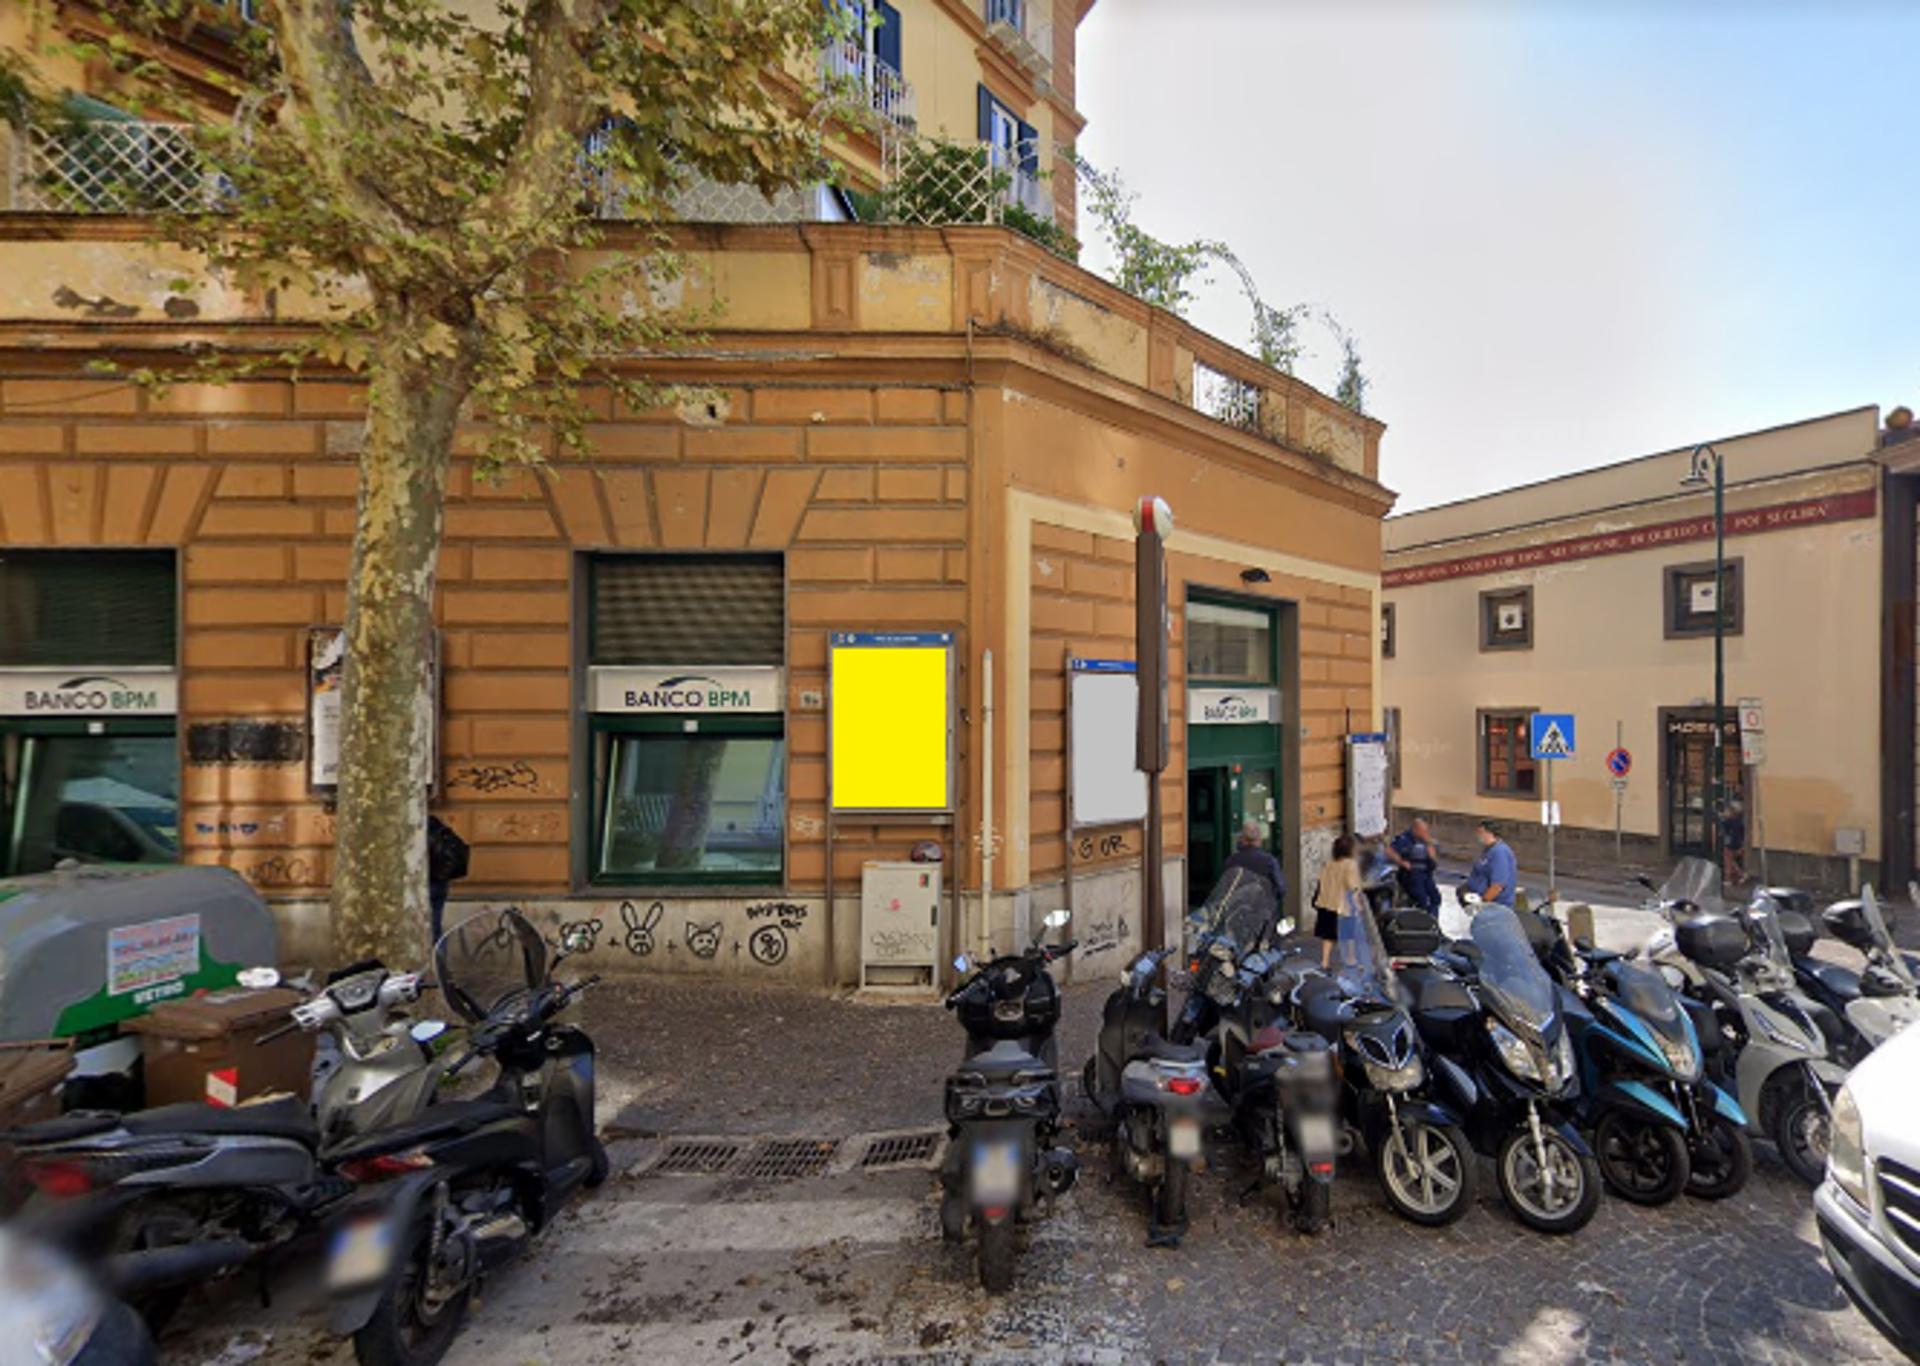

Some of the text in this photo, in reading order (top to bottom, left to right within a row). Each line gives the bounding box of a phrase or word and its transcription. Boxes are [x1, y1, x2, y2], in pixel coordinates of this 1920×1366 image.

[25, 691, 157, 710] BANCO BPM
[625, 690, 751, 708] BANCO BPM
